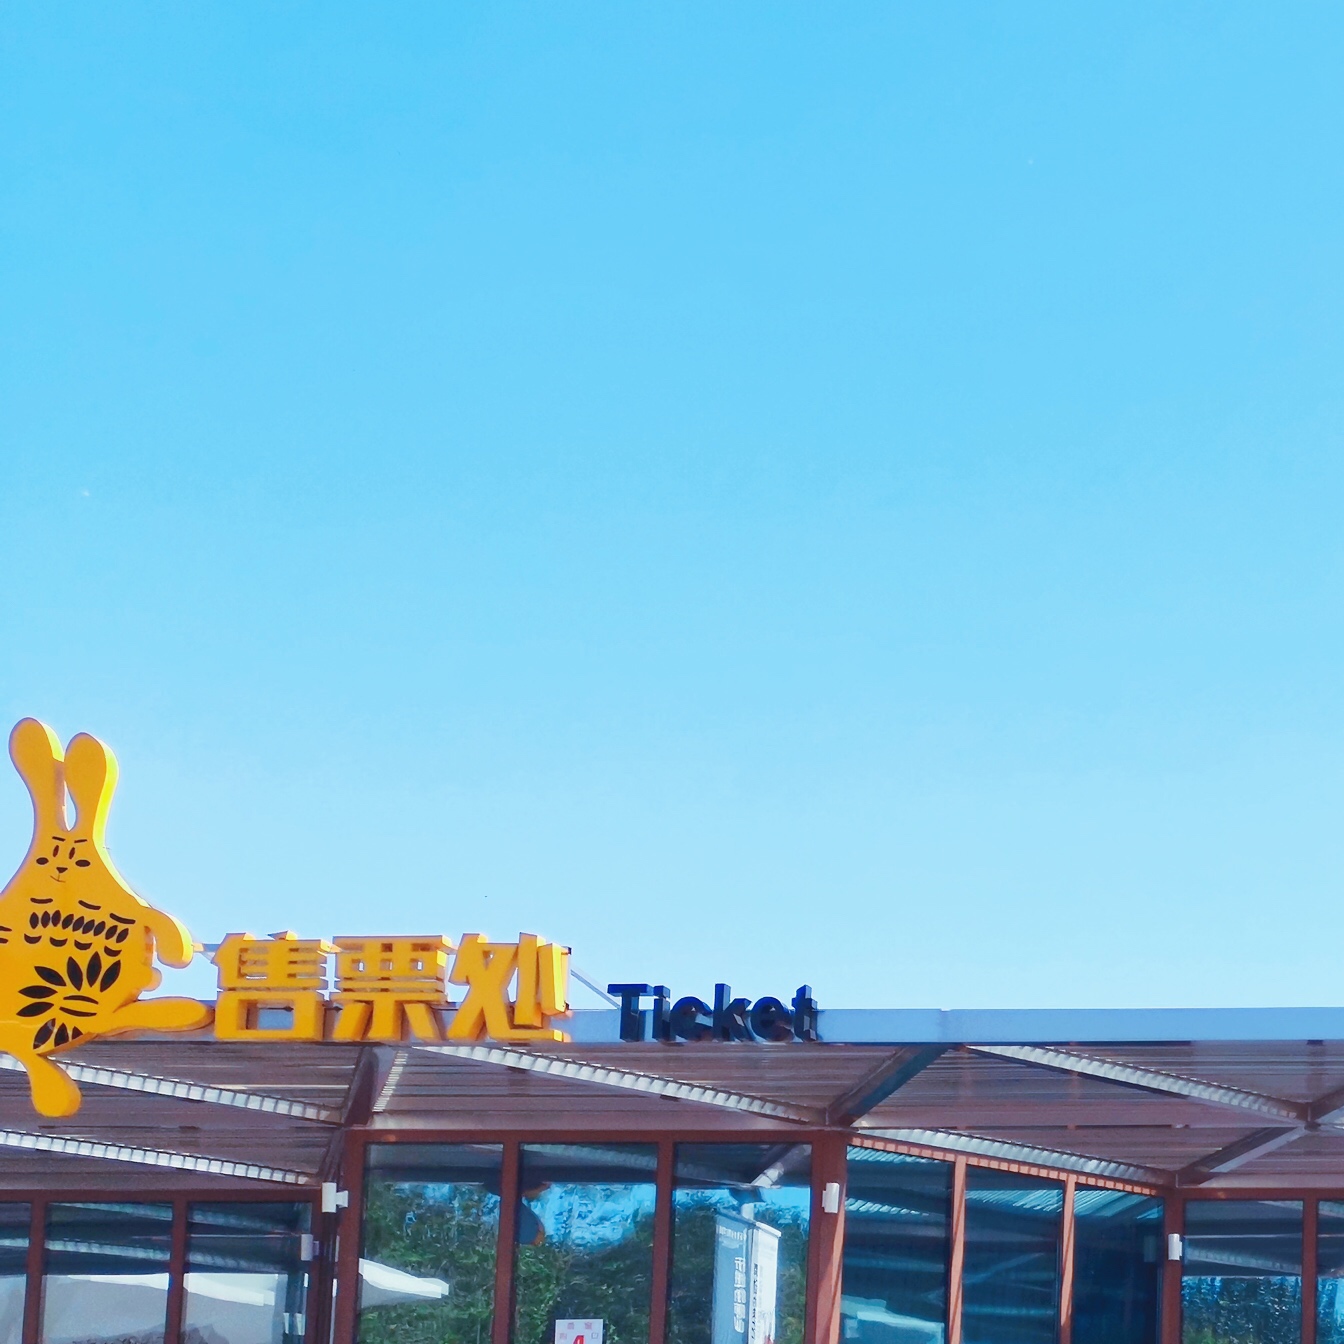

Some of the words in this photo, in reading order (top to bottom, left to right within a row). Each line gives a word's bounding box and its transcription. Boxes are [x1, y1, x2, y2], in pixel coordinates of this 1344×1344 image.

[213, 931, 571, 1042] 售票处
[607, 983, 819, 1042] Ticket
